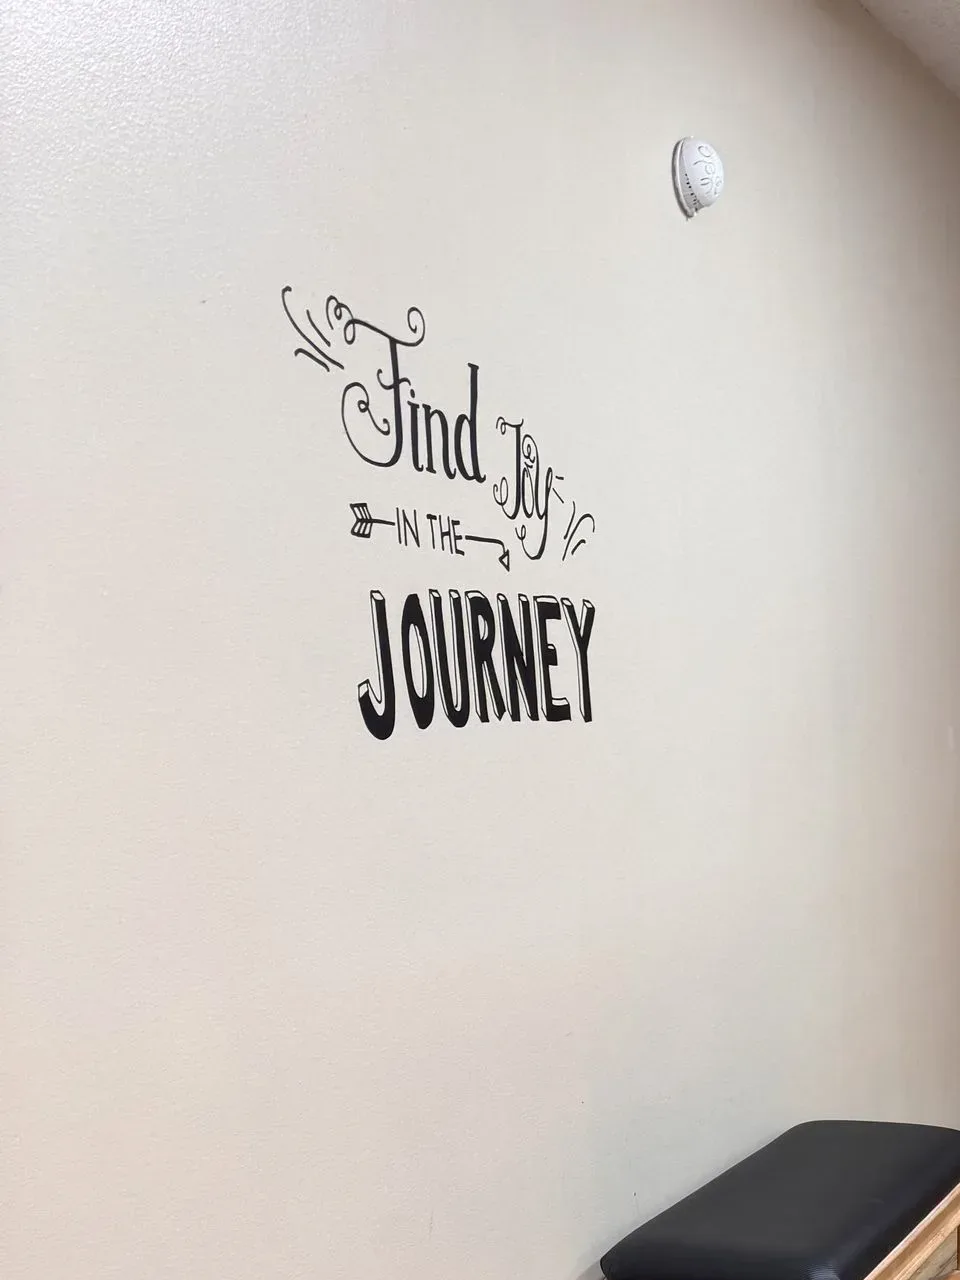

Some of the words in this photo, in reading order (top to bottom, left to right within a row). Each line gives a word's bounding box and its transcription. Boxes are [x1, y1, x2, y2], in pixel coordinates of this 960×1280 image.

[327, 295, 486, 484] Find
[492, 416, 554, 561] Joy
[394, 506, 421, 549] IN
[426, 513, 466, 556] THE
[357, 588, 596, 741] JOURNEY
